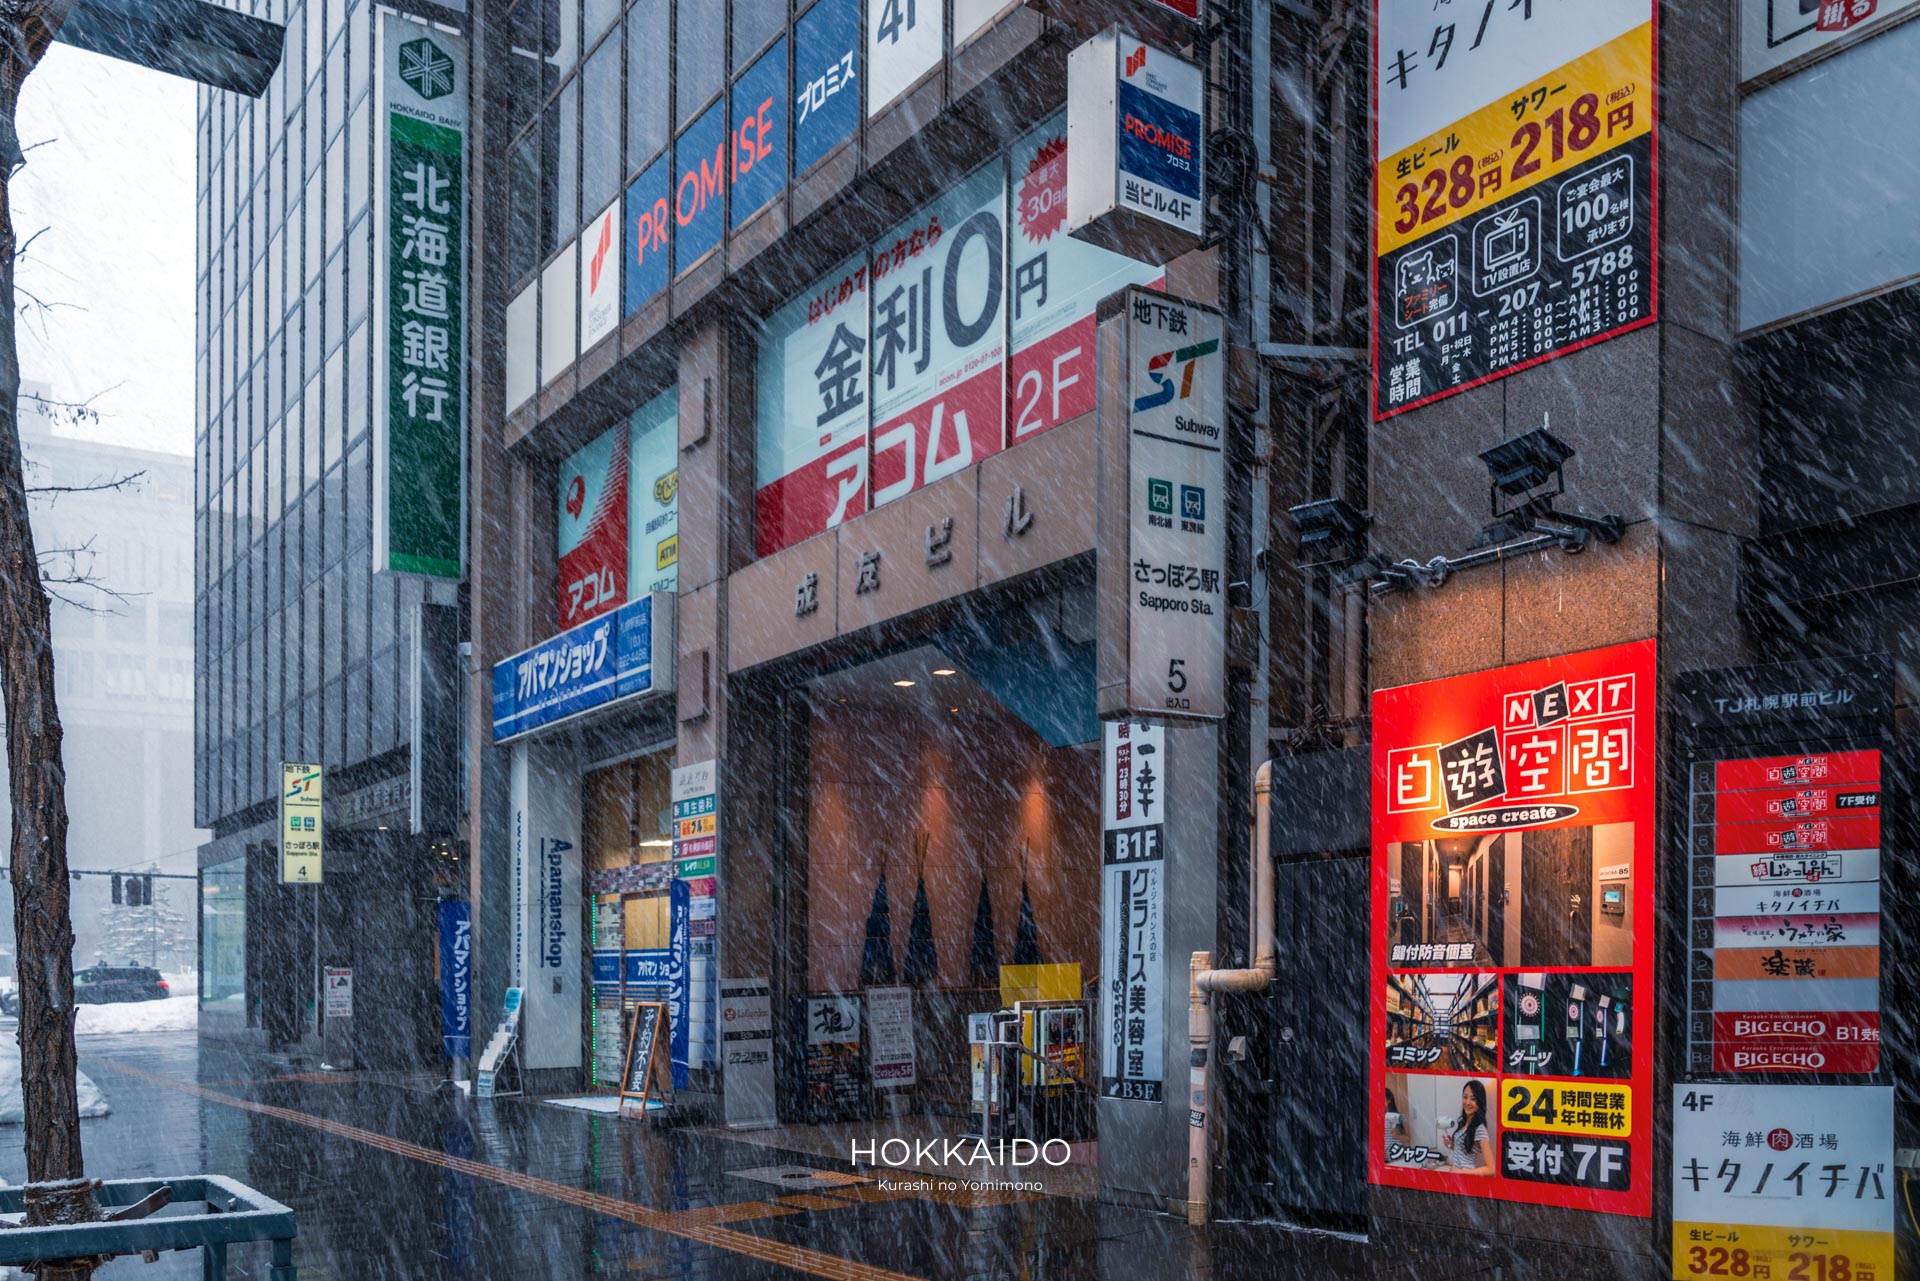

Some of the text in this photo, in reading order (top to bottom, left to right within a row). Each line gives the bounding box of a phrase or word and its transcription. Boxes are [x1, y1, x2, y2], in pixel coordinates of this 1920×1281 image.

[877, 0, 916, 46] 4
[797, 49, 856, 125] プロミス
[1605, 82, 1636, 107] (税込)
[390, 101, 463, 128] HOKKAIDO BANK
[1510, 83, 1568, 121] サワー
[1124, 112, 1192, 161] PROMISE
[1510, 93, 1635, 183] 218円
[1166, 152, 1191, 172] プロミス
[1396, 134, 1460, 180] 生ビール
[1477, 148, 1504, 170] (税込)
[637, 96, 774, 266] PROMISE
[1394, 154, 1502, 235] 328円
[1566, 167, 1624, 202] ご宴会最大
[1125, 178, 1192, 223] 当ビル4F
[1562, 191, 1630, 235] 100名様
[1586, 215, 1630, 244] 承ります
[807, 215, 944, 327] はじめての方なら
[1482, 258, 1531, 289] TV設置店
[401, 161, 449, 421] 北海道銀行
[1404, 283, 1449, 309] ファミリー
[1132, 296, 1189, 337] 地下鉄
[1404, 293, 1449, 322] シート完備
[1393, 330, 1425, 356] TEL
[1389, 357, 1421, 387] 営業
[1451, 362, 1461, 374] 金
[1451, 374, 1461, 386] 土
[1014, 345, 1082, 439] 2F
[1389, 376, 1421, 404] 時間
[1174, 414, 1220, 440] Subway
[825, 401, 974, 531] アコム
[660, 543, 676, 562] ATM
[1133, 557, 1220, 595] さっぽろ駅
[567, 564, 616, 621] アコム
[1139, 591, 1213, 616] Sapporo Sta.
[518, 621, 610, 702] アパマンショップ
[1167, 659, 1187, 694] 5
[1166, 696, 1190, 710] 出入口
[1509, 682, 1627, 723] NEXT
[1714, 688, 1852, 714] TJ札幌駅前ビル
[285, 765, 310, 774] 地下鉄
[1135, 721, 1157, 818] 一幸
[1397, 728, 1629, 806] 自遊空間
[1768, 764, 1827, 781] 自遊空間
[1797, 757, 1826, 765] NEXT
[1768, 796, 1827, 813] 自遊空間
[1797, 789, 1826, 797] NEXT
[1839, 795, 1876, 807] 7F受付
[1450, 805, 1557, 829] space create
[1797, 822, 1826, 830] NEXT
[285, 841, 320, 850] さっぽろ駅
[1116, 830, 1157, 861] B1F
[1768, 828, 1827, 846] 自遊空間
[298, 866, 307, 877] 4
[545, 837, 573, 968] Apamanshop
[1756, 899, 1840, 913] キタノイチバ
[1391, 943, 1474, 961] 鍵付防音個室
[454, 920, 472, 1031] アパマンショップ
[1127, 867, 1150, 1078] グラース美容室
[1735, 1020, 1770, 1036] BIG
[1773, 1020, 1826, 1036] ECHO
[1391, 1046, 1441, 1062] コミック
[1509, 1050, 1552, 1067] ダーツ
[1734, 1052, 1826, 1068] BIG ECHO
[1122, 1082, 1155, 1099] B3F
[1681, 1091, 1714, 1112] 4F
[1507, 1085, 1625, 1125] 24 時間営業
[1561, 1109, 1625, 1130] 年中無休
[1390, 1144, 1440, 1162] シャワー
[1722, 1128, 1839, 1151] 海鮮肉酒場
[1508, 1141, 1624, 1182] 受付 7F
[1681, 1157, 1885, 1200] キタノイチバ
[1689, 1228, 1828, 1248] 生ビール サワー
[1688, 1245, 1771, 1279] 328円
